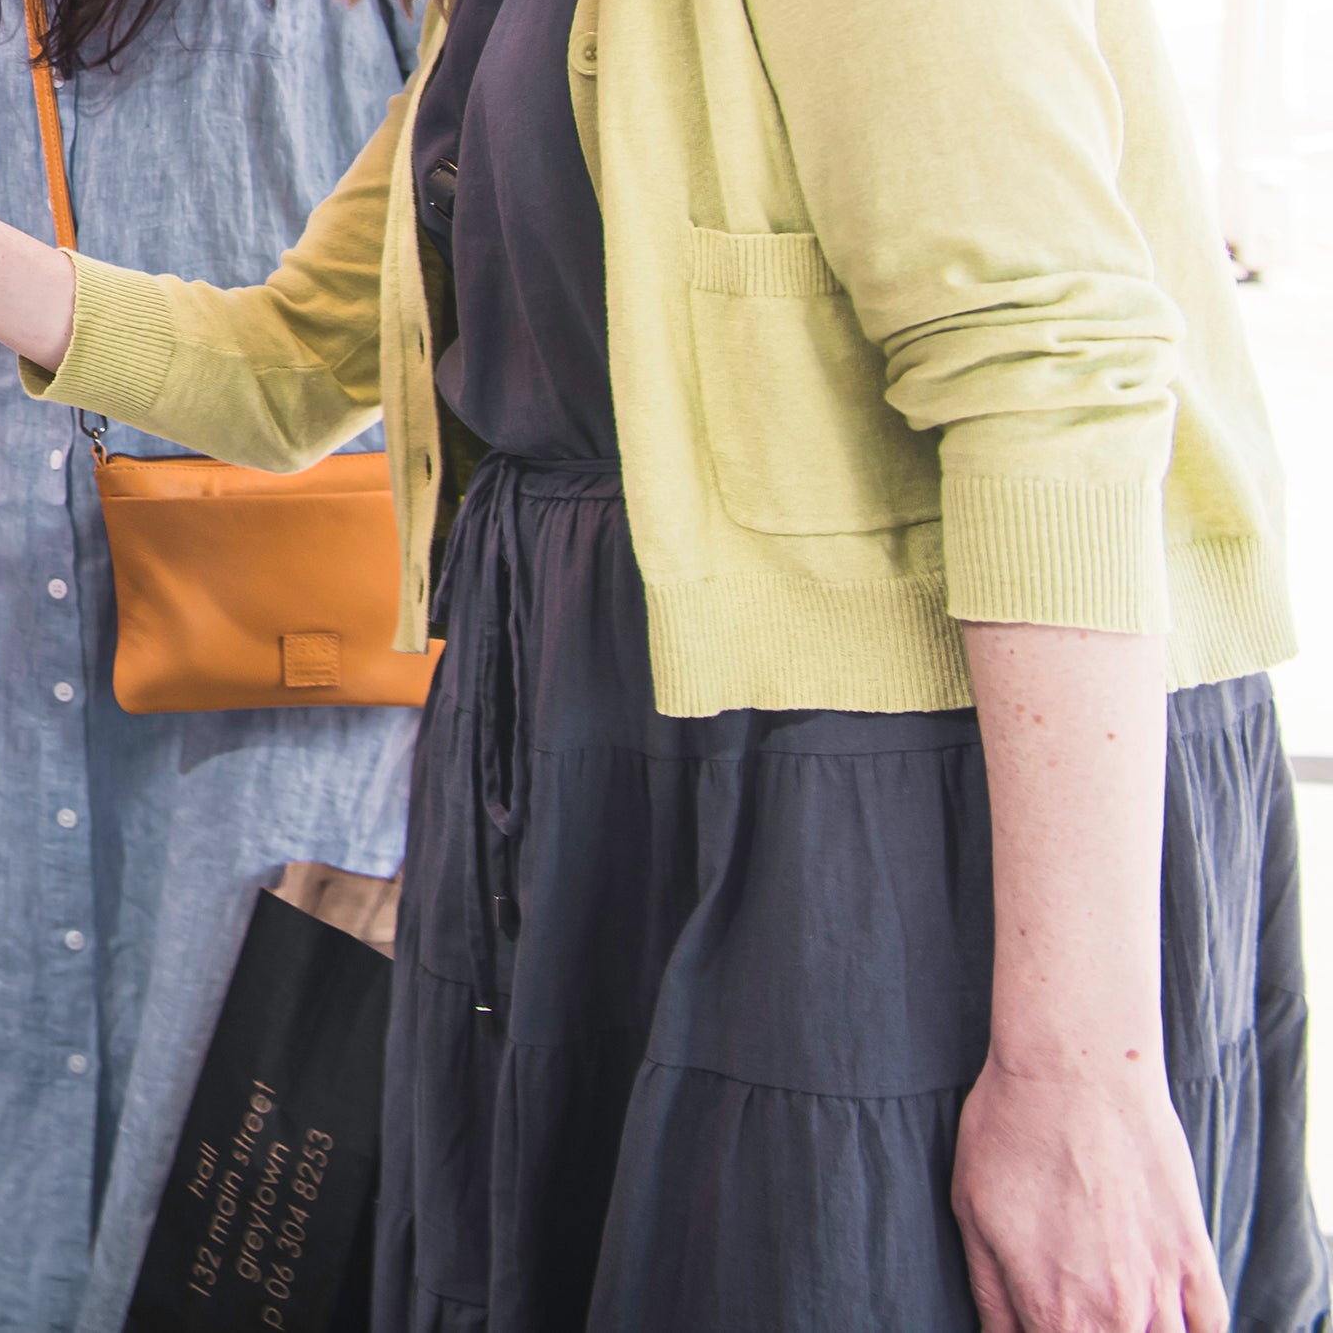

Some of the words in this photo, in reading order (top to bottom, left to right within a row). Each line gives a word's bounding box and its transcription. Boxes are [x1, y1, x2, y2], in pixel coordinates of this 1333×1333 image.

[187, 1141, 220, 1200] hall
[188, 1246, 222, 1299] 132
[209, 1168, 244, 1247] main
[232, 1080, 277, 1167] street
[290, 1128, 334, 1204] 8253
[235, 1141, 292, 1284] greytown
[279, 1204, 312, 1261] 304
[263, 1263, 296, 1304] 06
